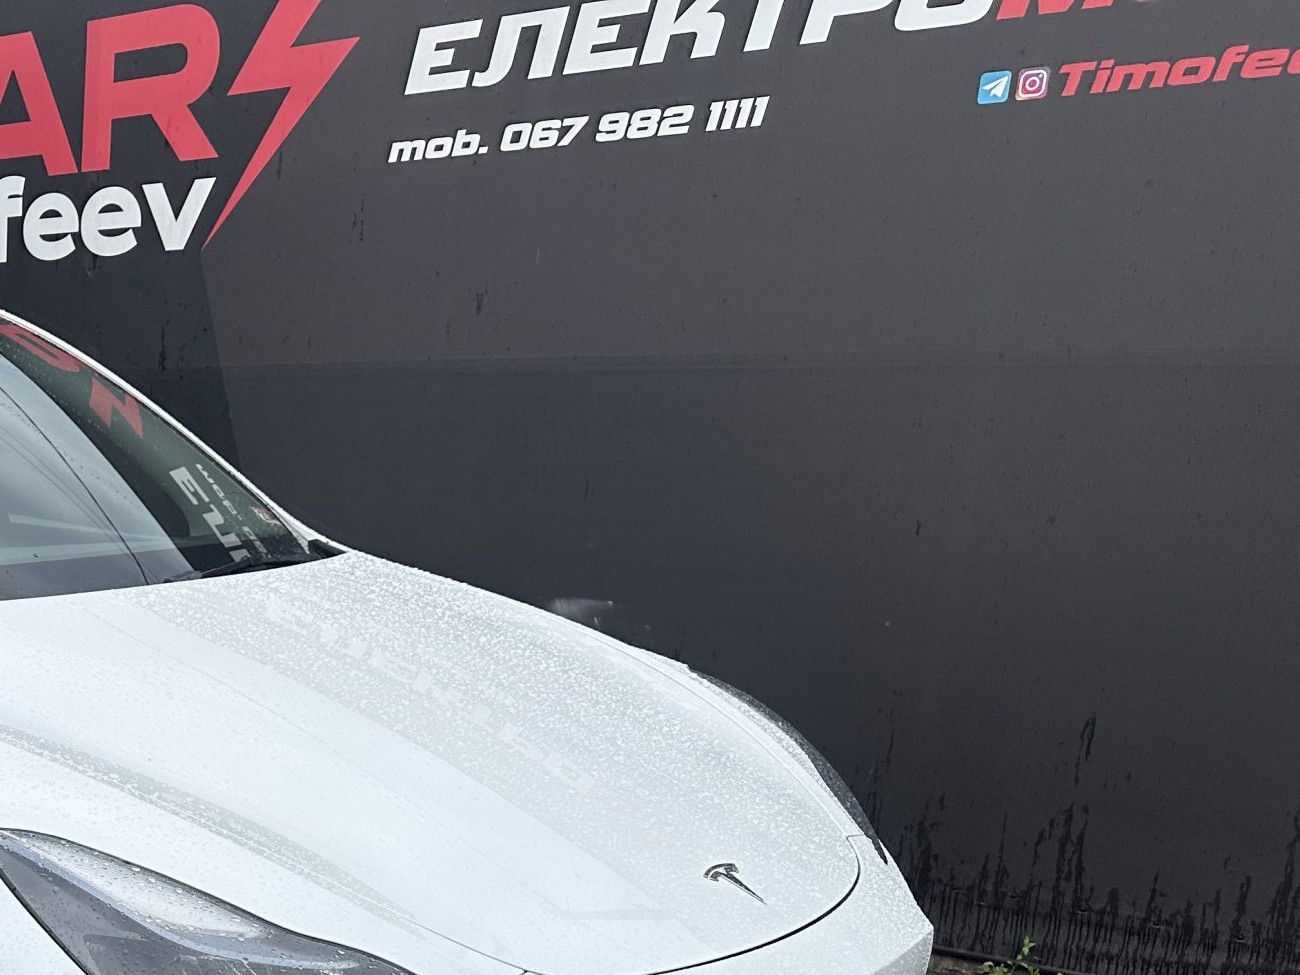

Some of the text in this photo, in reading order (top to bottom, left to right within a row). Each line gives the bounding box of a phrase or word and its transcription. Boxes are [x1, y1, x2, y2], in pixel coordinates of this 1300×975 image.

[403, 0, 1149, 96] ЕЛЕКТР
[1058, 44, 1300, 97] Timofe
[387, 96, 770, 164] mob. 067 982 1111
